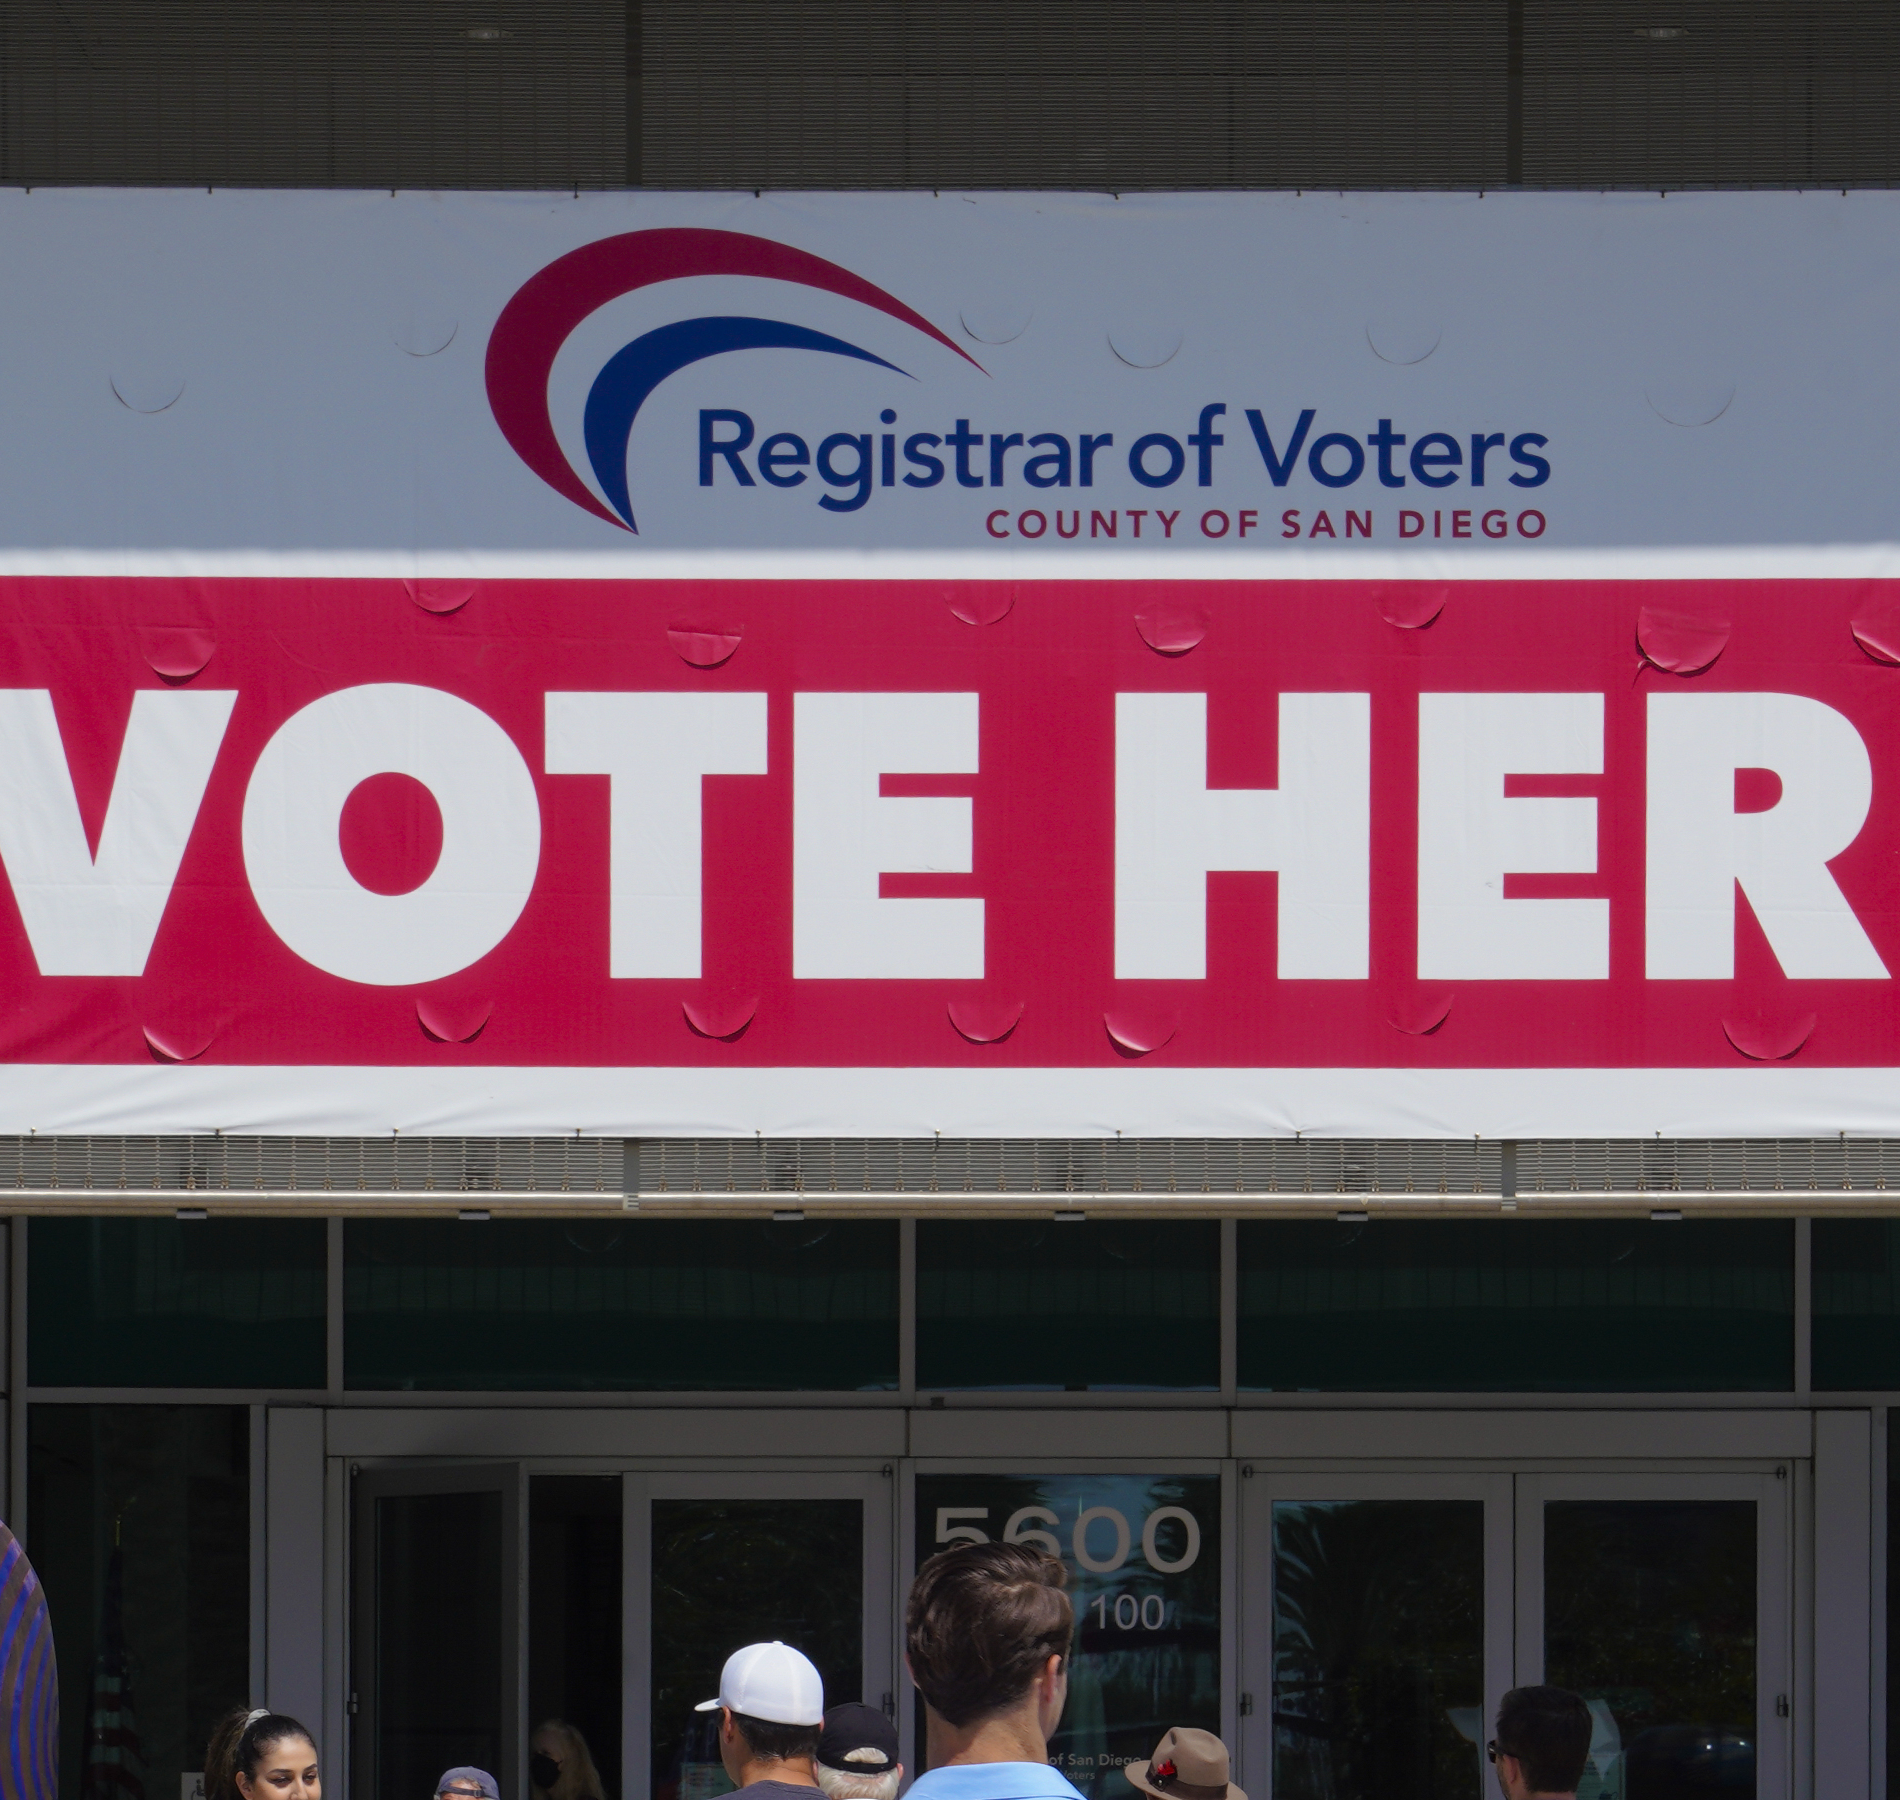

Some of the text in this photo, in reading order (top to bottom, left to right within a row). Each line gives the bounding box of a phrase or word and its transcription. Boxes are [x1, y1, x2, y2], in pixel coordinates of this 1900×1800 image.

[698, 402, 1552, 512] Registrar of Voters
[986, 509, 1546, 539] COUNTY OF SAN DIEGO
[1090, 1594, 1165, 1631] 100
[1068, 1754, 1094, 1766] San
